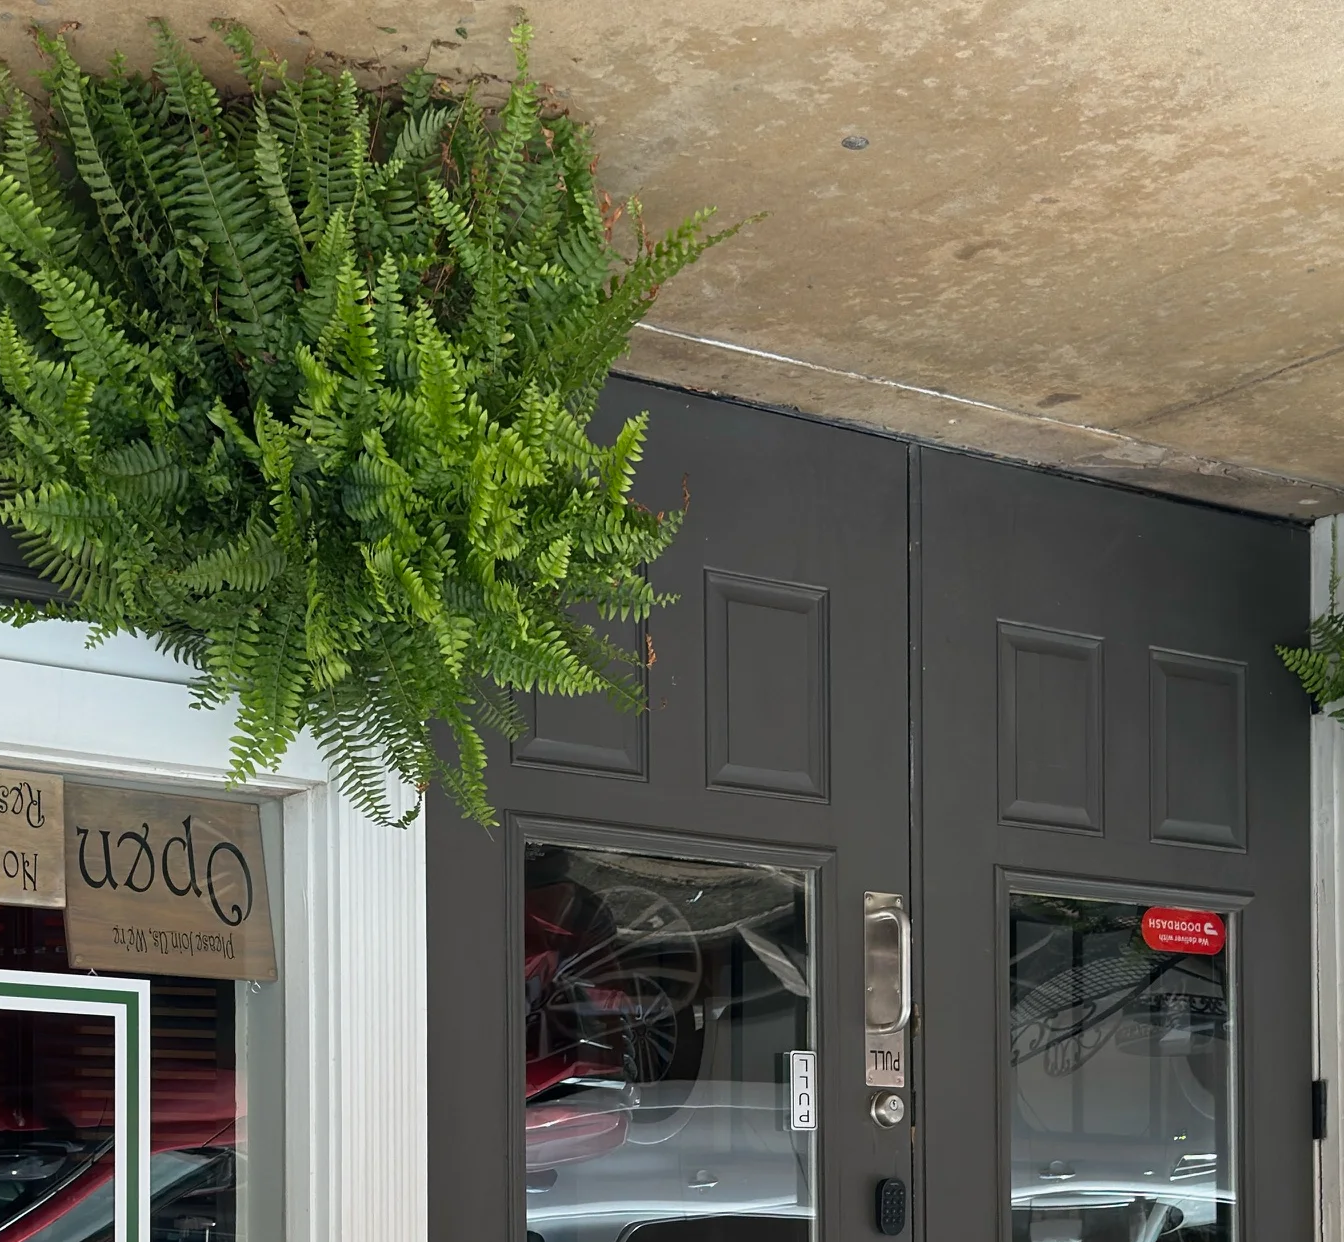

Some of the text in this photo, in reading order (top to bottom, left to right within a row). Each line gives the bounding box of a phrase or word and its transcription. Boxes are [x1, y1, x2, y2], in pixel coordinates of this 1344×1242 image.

[2, 850, 39, 892] No
[76, 814, 253, 927] Open
[111, 925, 236, 960] Please Join Us, We're
[1148, 918, 1201, 933] DOORDASH
[1158, 934, 1209, 947] We deliver with
[869, 1050, 900, 1072] PULL
[798, 1058, 810, 1123] PULL
